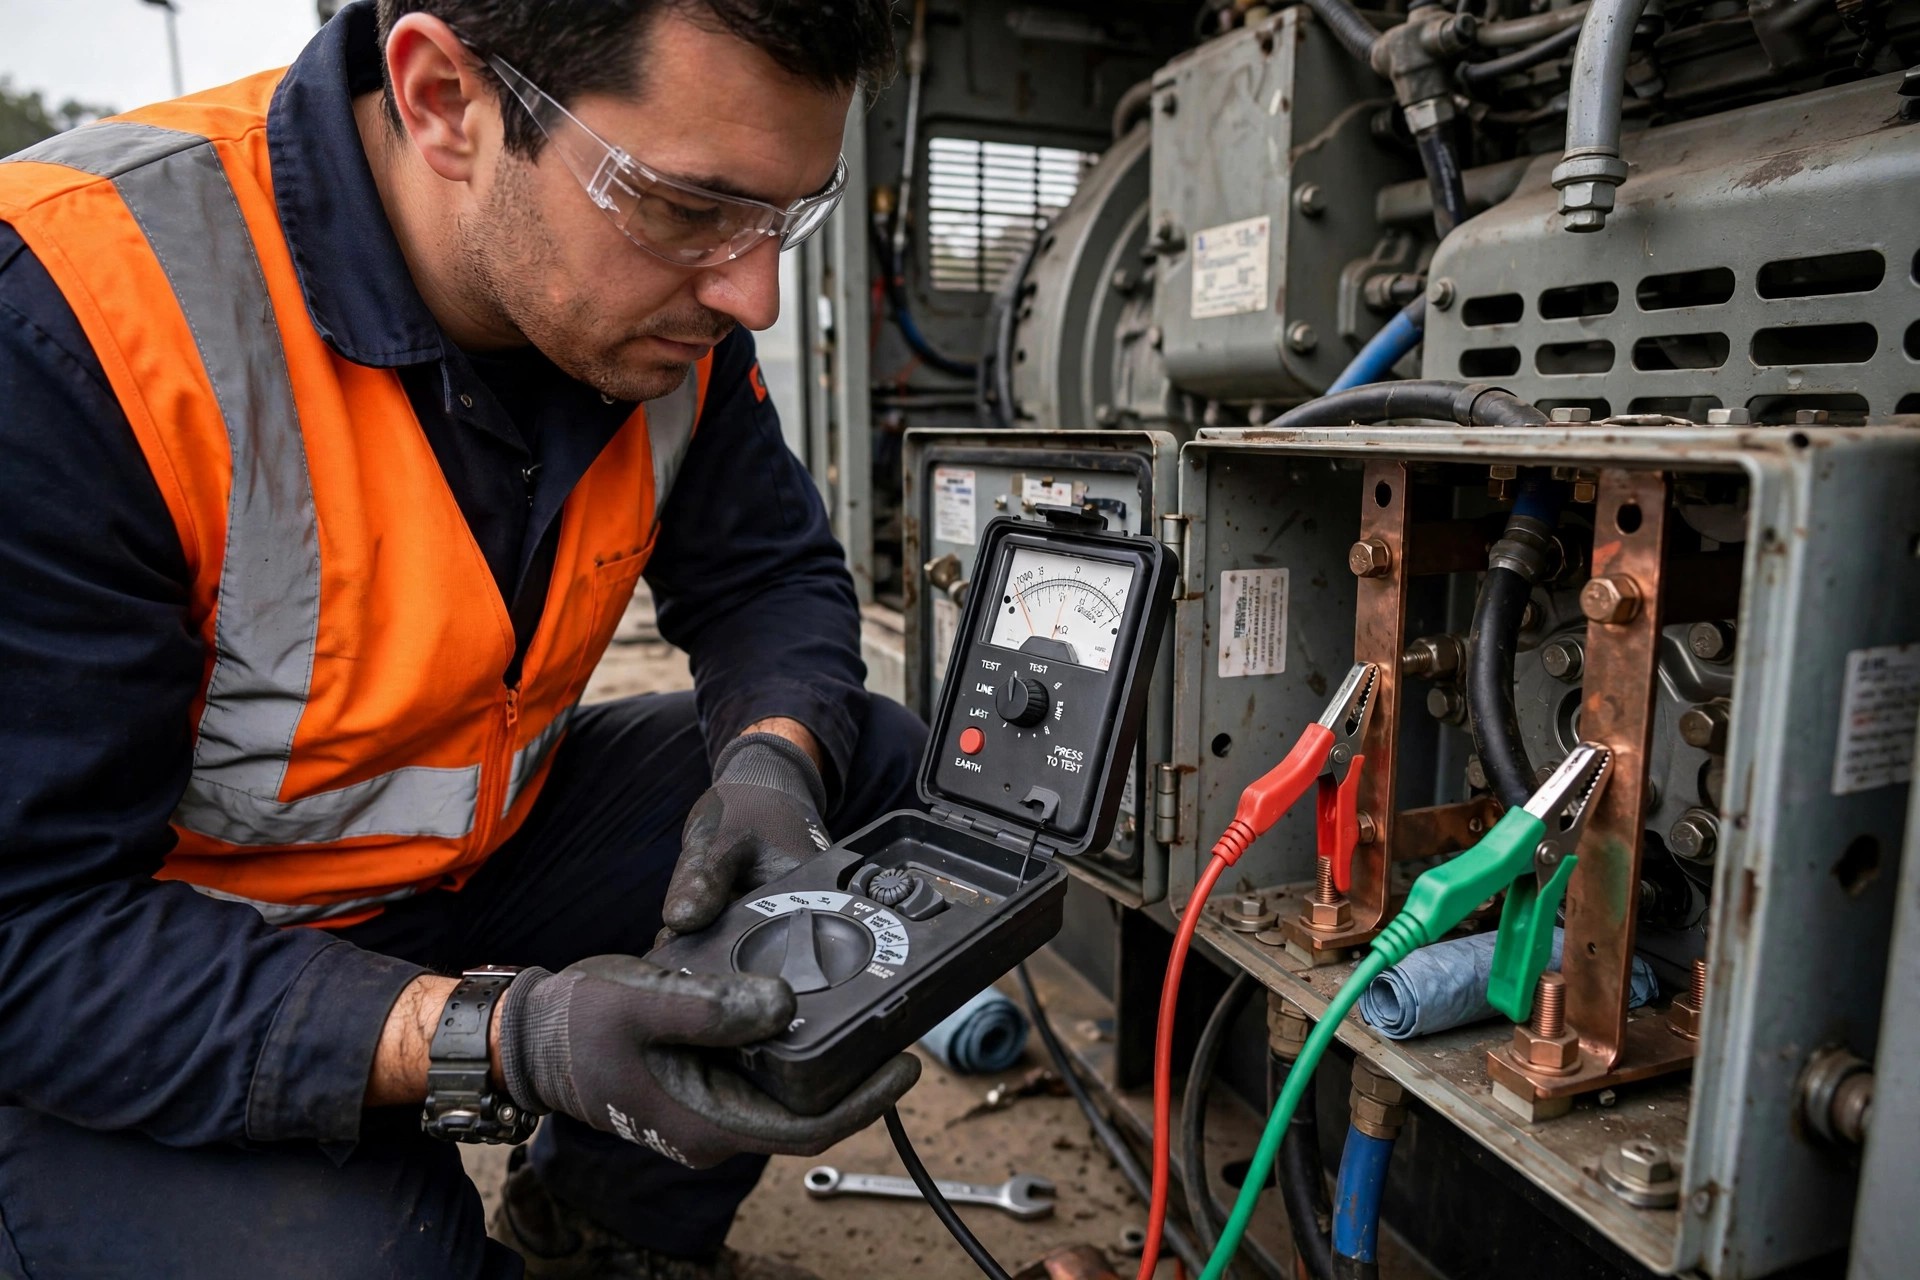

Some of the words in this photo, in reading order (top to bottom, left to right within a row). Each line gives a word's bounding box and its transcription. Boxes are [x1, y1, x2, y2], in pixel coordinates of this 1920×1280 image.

[981, 659, 1002, 672] TEST
[1029, 662, 1049, 674] TEST
[976, 682, 995, 695] LINE
[1053, 745, 1084, 761] PRESS
[955, 757, 982, 773] EARTH
[1046, 755, 1058, 767] TO
[1061, 759, 1082, 773] TEST
